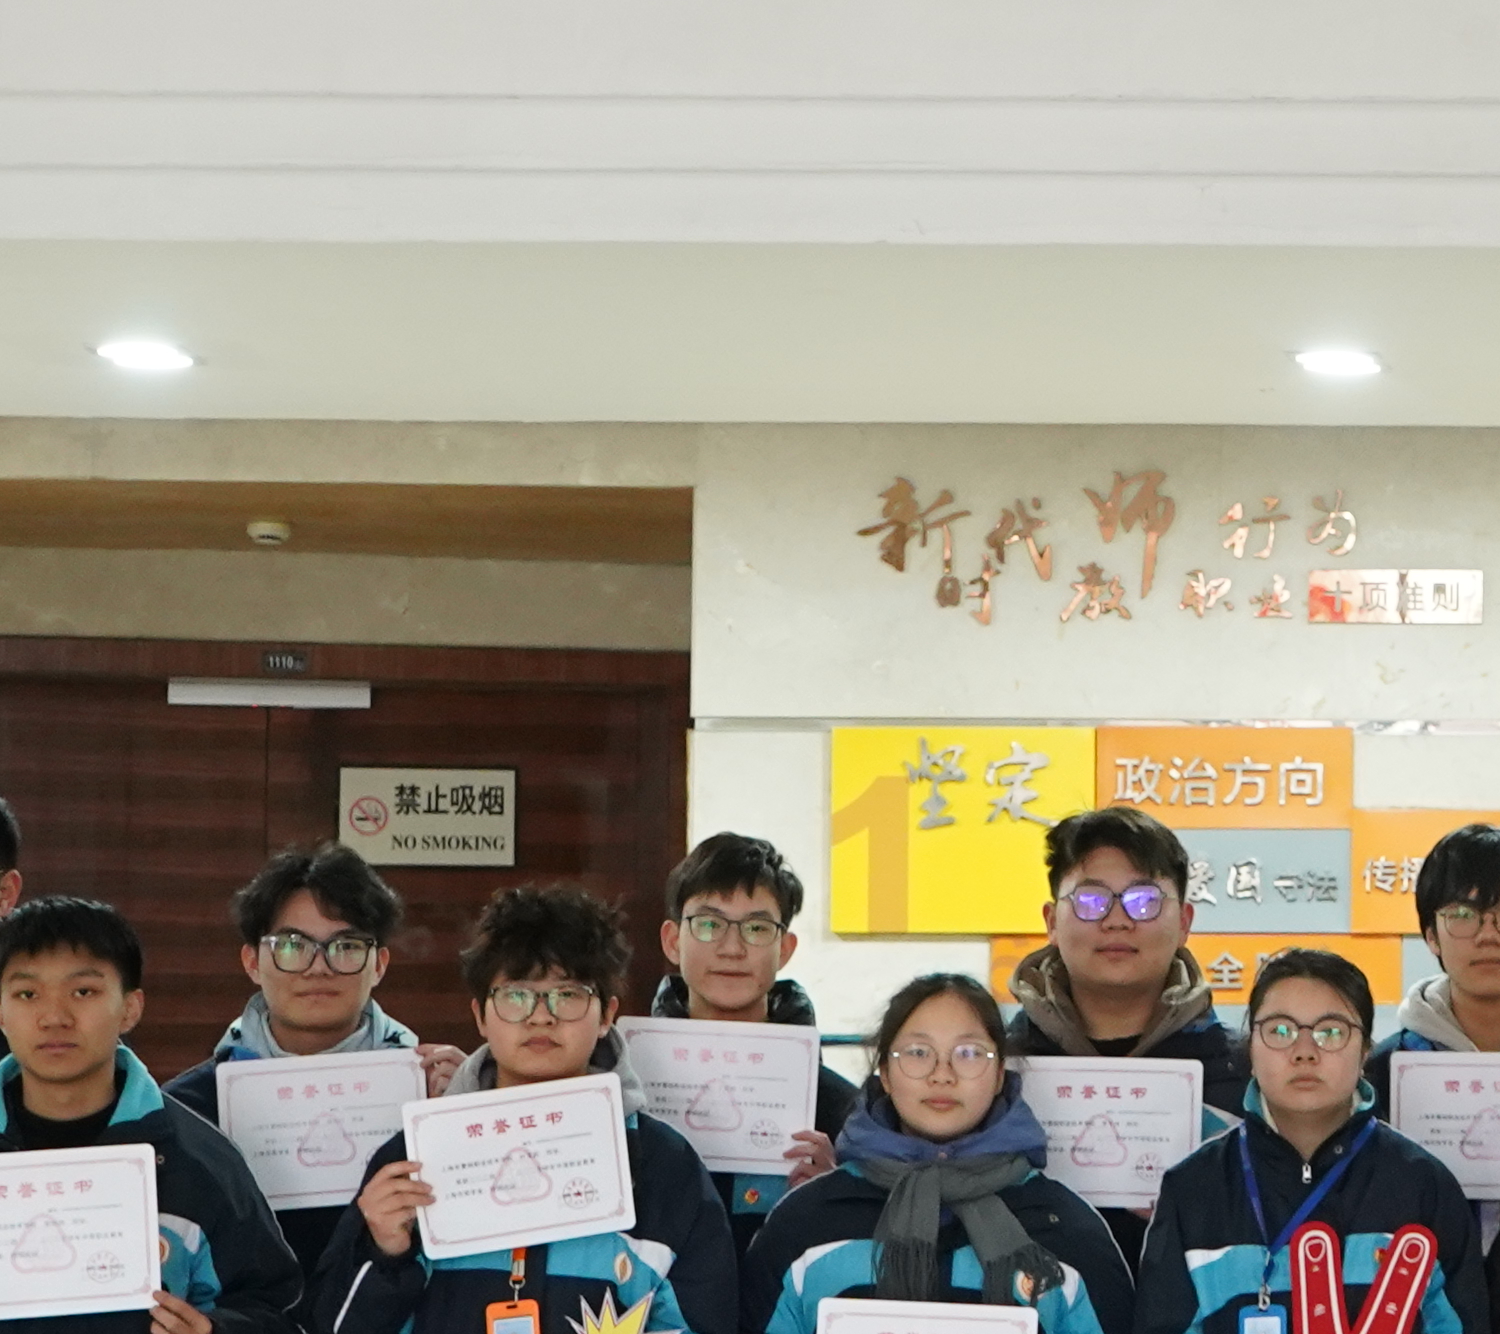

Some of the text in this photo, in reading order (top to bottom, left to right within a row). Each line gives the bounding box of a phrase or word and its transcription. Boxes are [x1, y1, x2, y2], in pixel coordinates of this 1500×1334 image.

[1324, 581, 1460, 612] 十项准则
[904, 736, 1325, 829] 坚定 政治方向
[395, 784, 504, 815] 禁止吸烟
[392, 835, 505, 851] NO SMOKING
